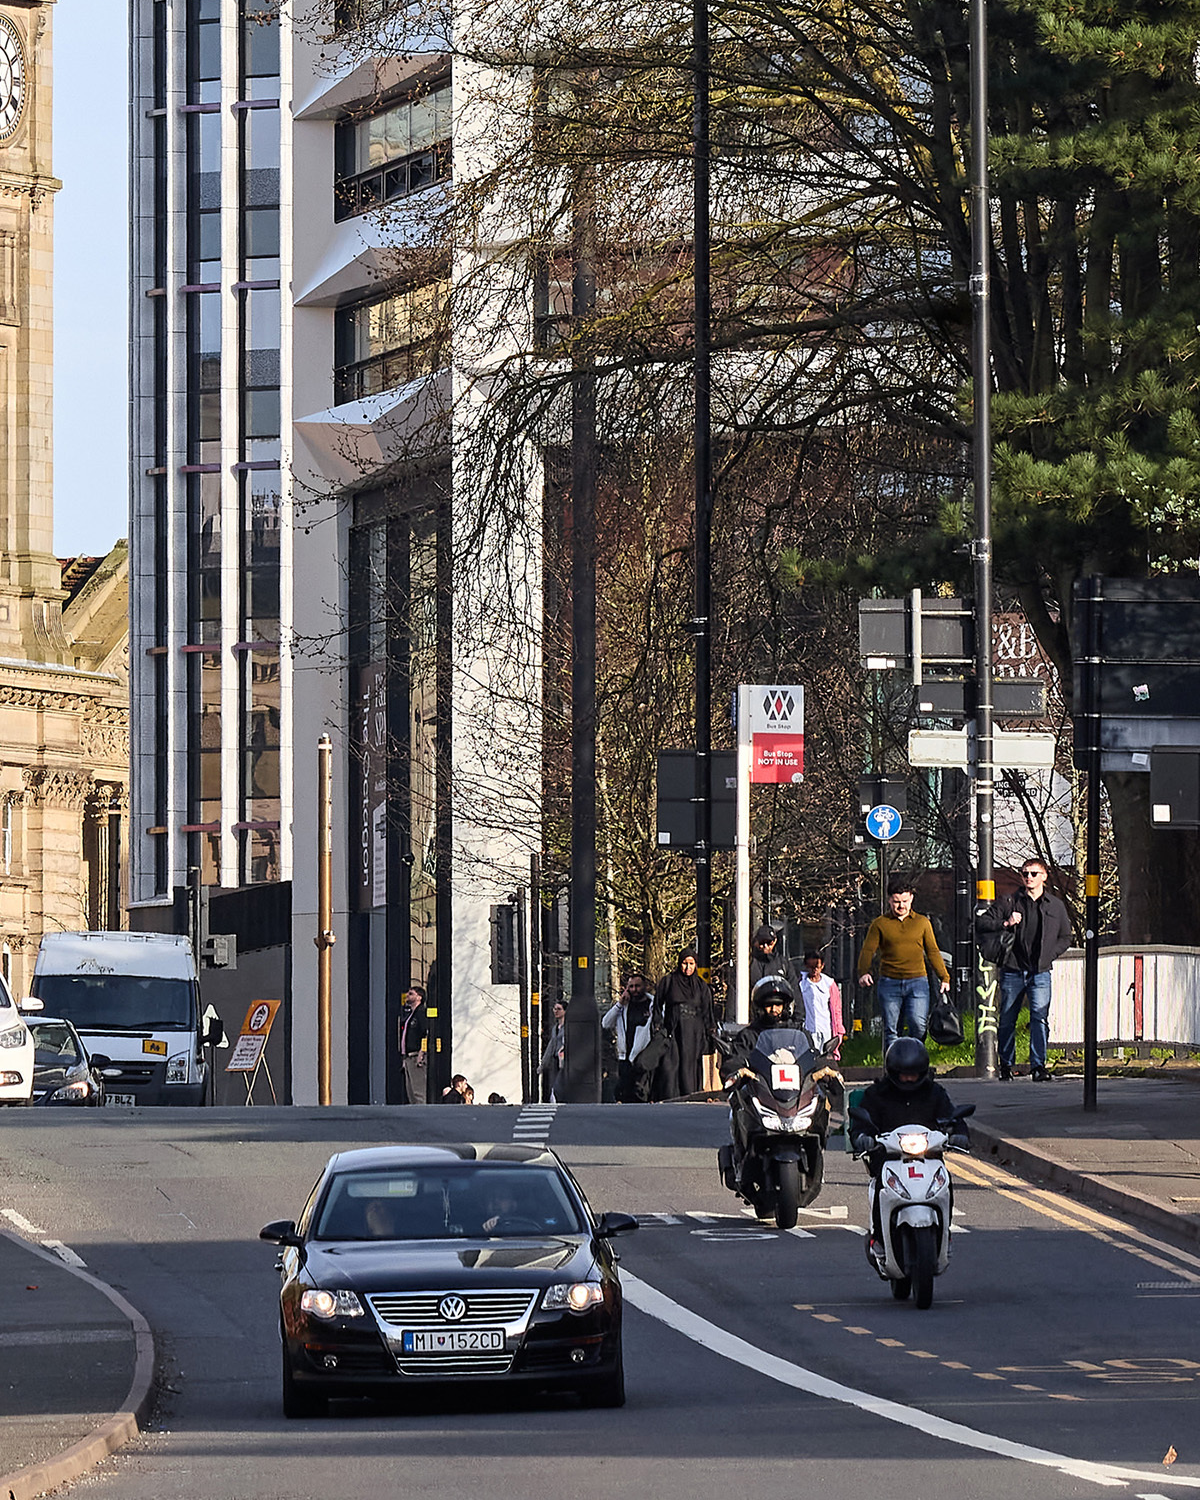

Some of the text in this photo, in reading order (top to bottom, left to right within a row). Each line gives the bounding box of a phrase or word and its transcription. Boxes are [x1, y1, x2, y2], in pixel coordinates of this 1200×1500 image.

[777, 750, 793, 758] Stop
[779, 1069, 793, 1082] L
[114, 1095, 133, 1105] BLZ
[908, 1167, 924, 1178] L
[415, 1332, 501, 1350] MI 152CD
